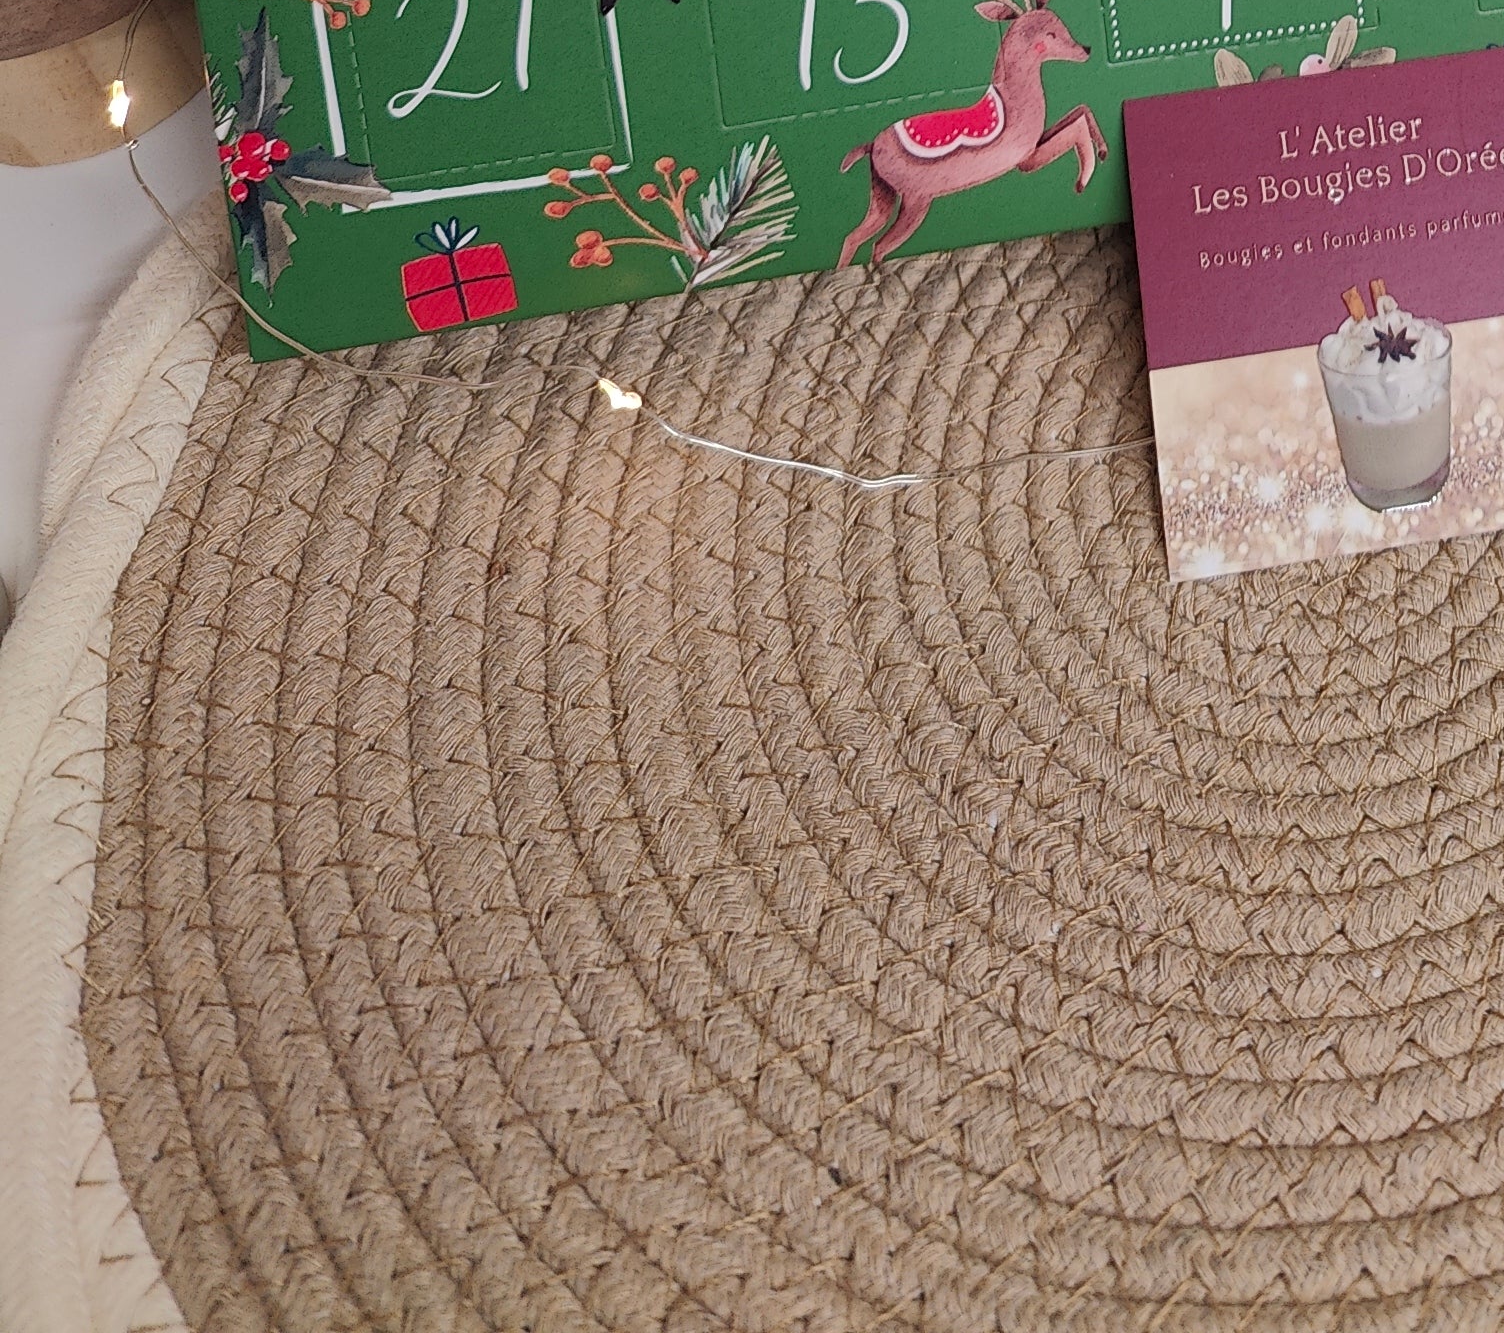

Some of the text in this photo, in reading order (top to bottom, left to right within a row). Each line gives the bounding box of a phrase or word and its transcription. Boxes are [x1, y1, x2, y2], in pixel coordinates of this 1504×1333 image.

[1310, 114, 1423, 157] Atelier
[1192, 185, 1249, 214] Les
[1258, 161, 1391, 205] Bougies
[1199, 244, 1283, 269] Bougies
[1293, 236, 1313, 254] et
[1322, 223, 1417, 250] fondants
